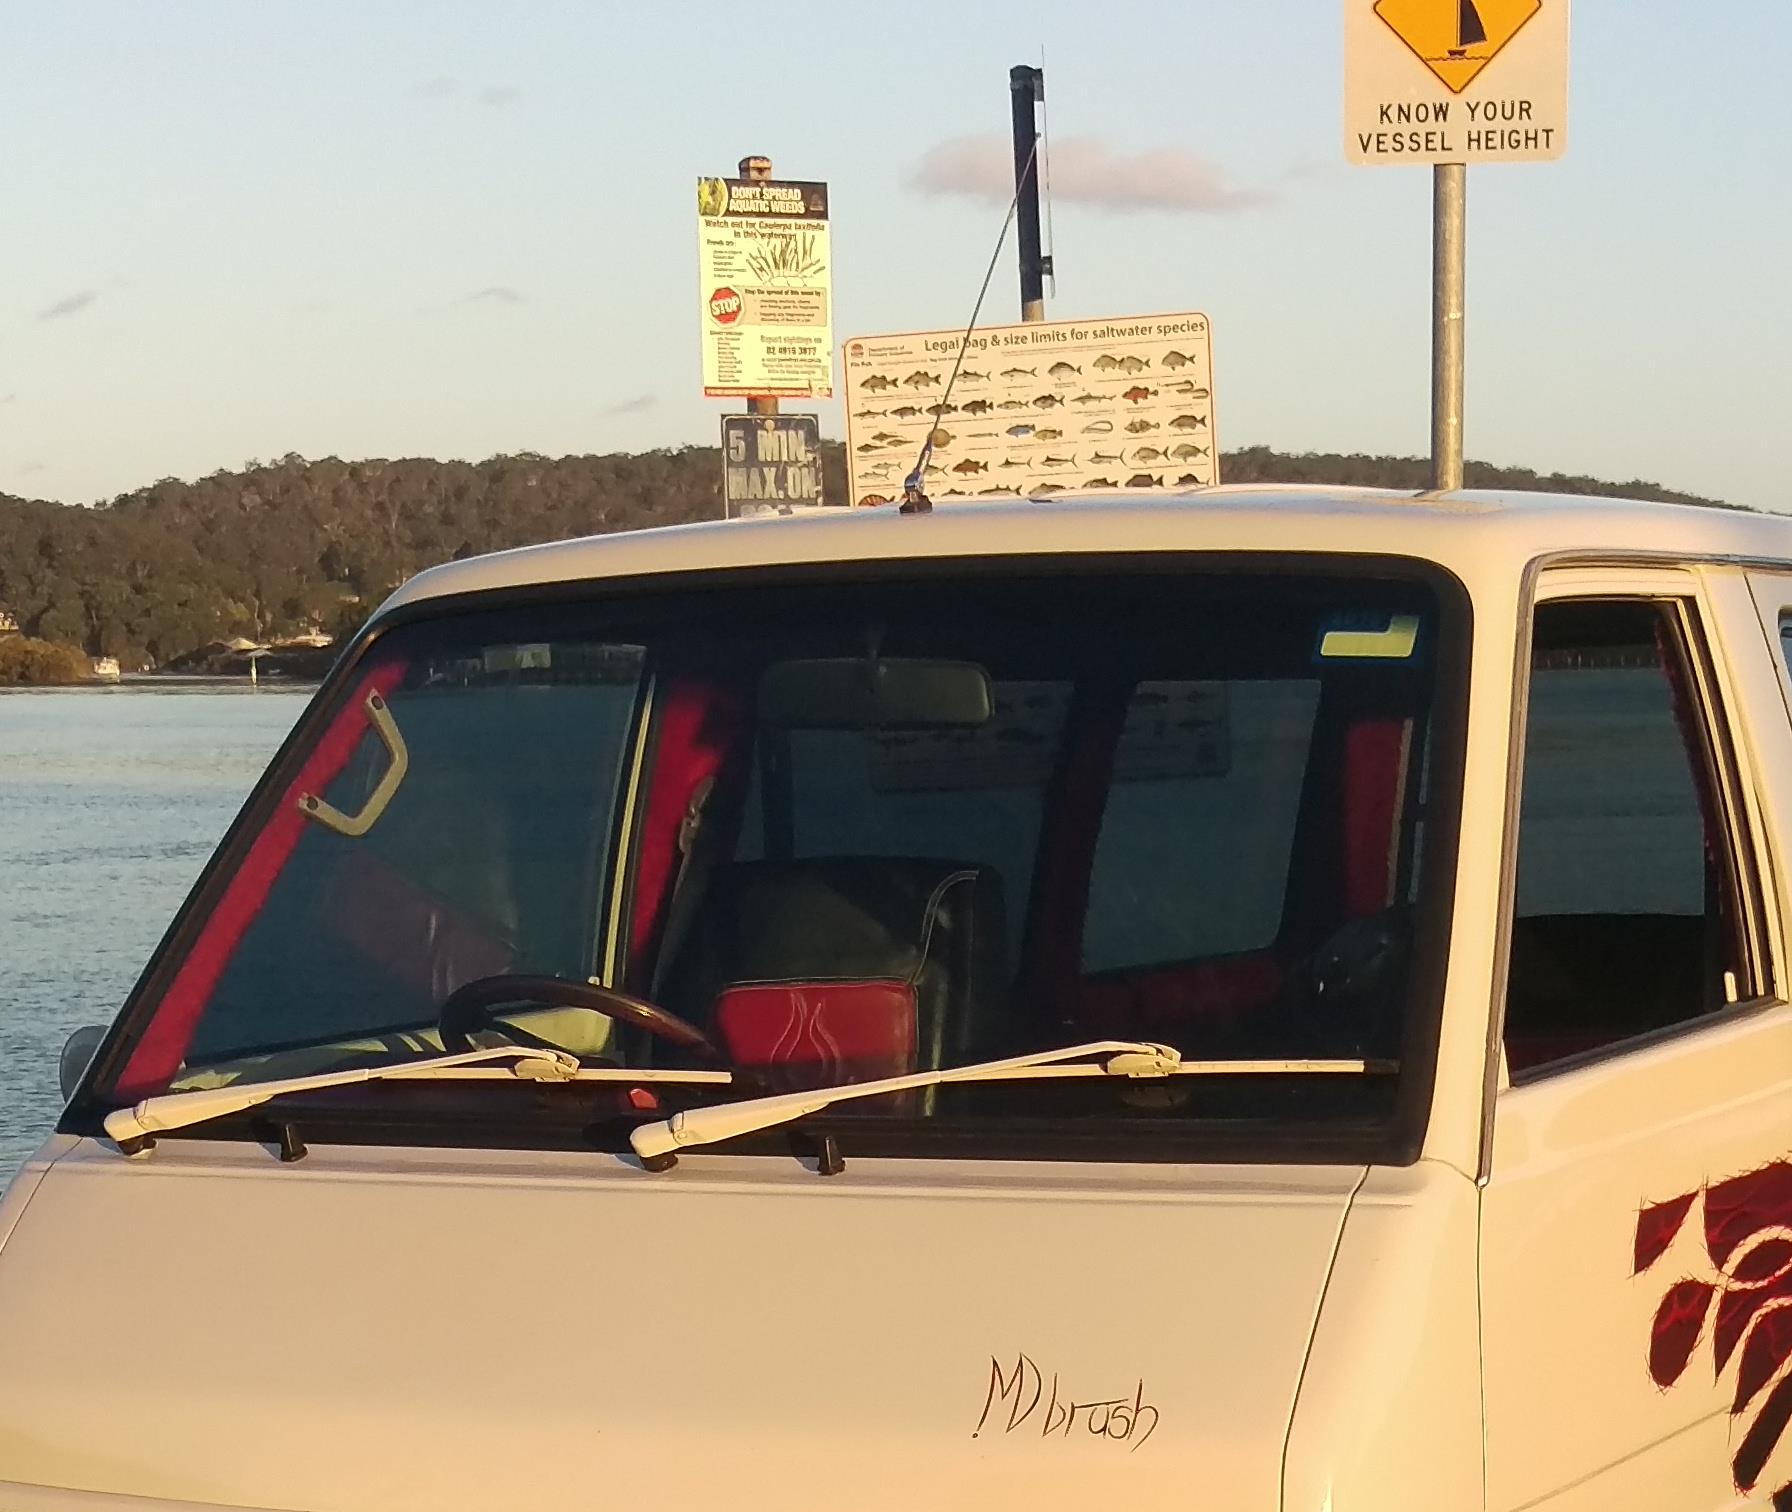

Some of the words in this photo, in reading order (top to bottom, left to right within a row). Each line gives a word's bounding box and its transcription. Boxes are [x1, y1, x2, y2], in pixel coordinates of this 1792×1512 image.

[1379, 102, 1450, 124] KNOW
[1465, 100, 1533, 121] YOUR
[1358, 131, 1453, 153] VESSEL
[1467, 128, 1555, 151] HEIGHT
[731, 186, 761, 199] DON'T
[762, 187, 802, 200] SPREAD
[729, 199, 770, 213] AQUATIC
[770, 201, 806, 214] WEEDS
[704, 219, 729, 228] Watch
[711, 297, 740, 316] STOP
[924, 336, 959, 353] Legal
[963, 335, 988, 351] bag
[990, 335, 1001, 346] &
[1003, 332, 1028, 346] size
[1031, 330, 1067, 344] limits
[1070, 327, 1089, 341] for
[1092, 324, 1153, 340] saltwater
[1157, 320, 1206, 337] species
[729, 430, 746, 462] 5
[787, 466, 817, 499] ON
